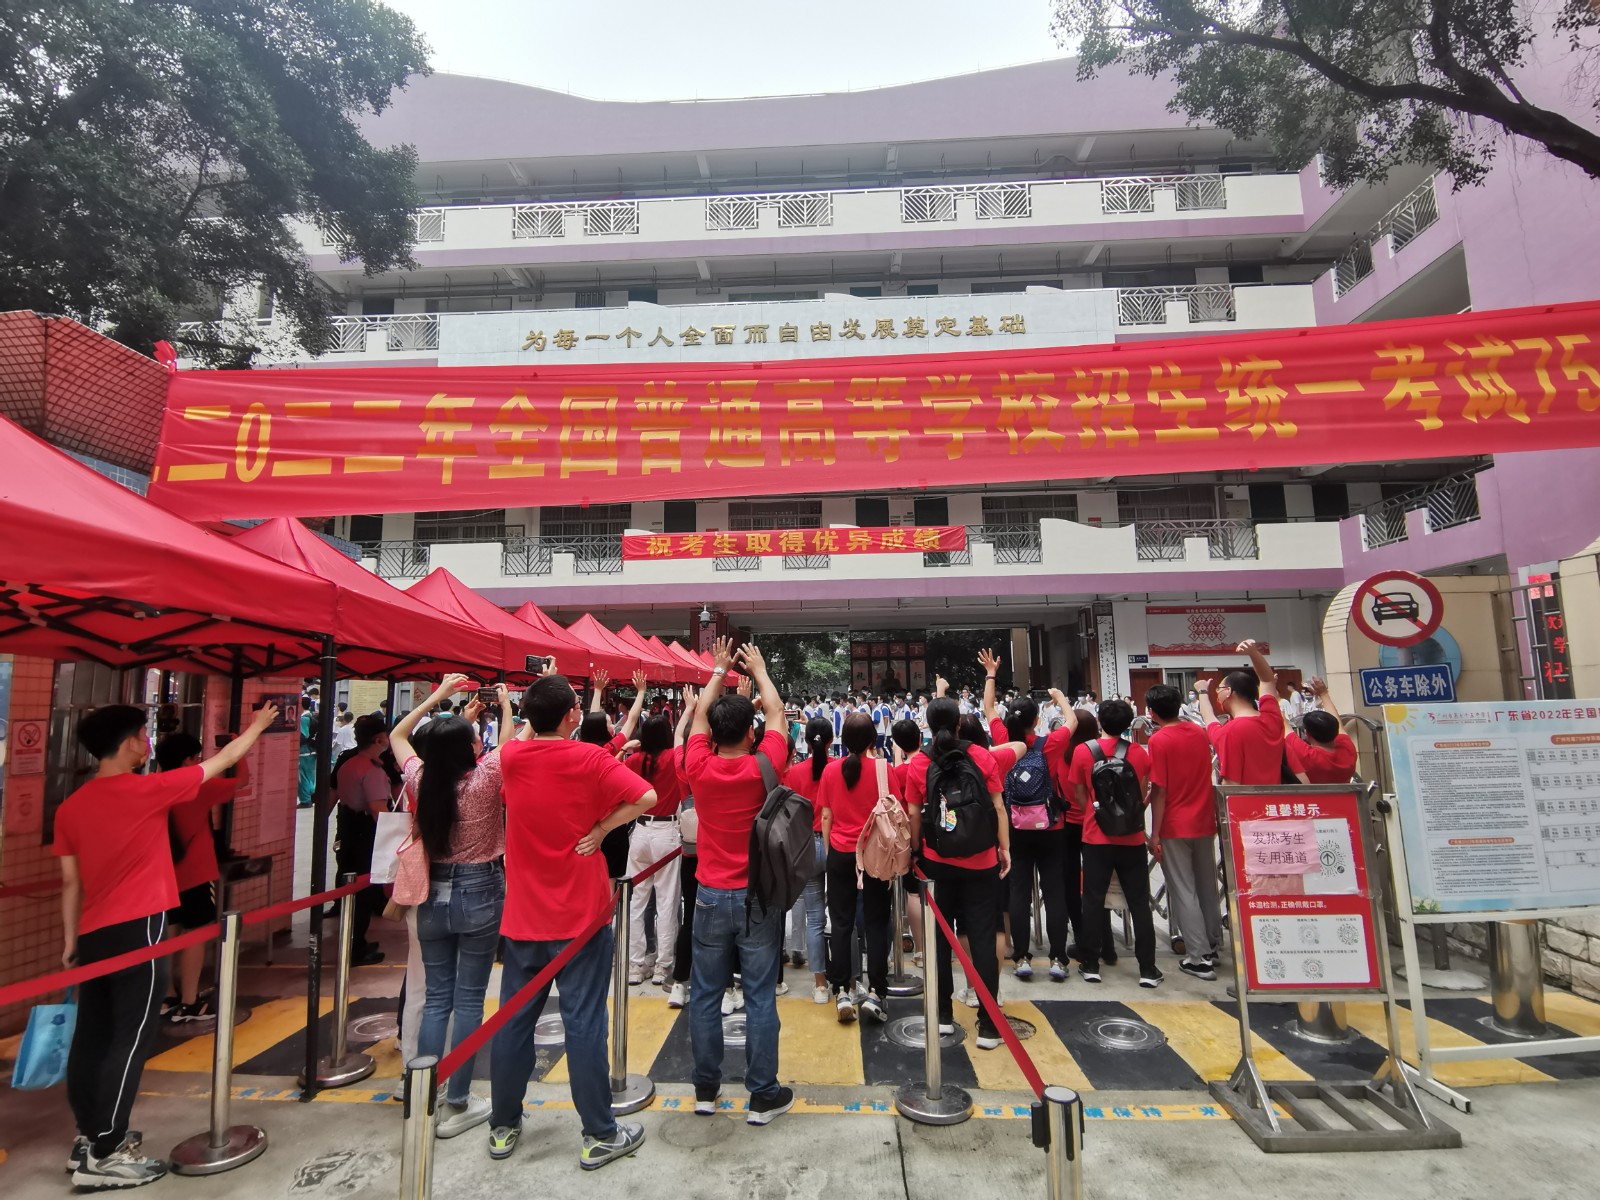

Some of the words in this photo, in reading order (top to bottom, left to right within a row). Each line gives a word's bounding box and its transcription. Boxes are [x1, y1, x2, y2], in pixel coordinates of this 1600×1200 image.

[522, 315, 1026, 351] 为每一个人全面而自由发展奠定基础
[647, 528, 941, 556] 祝考生取得优异成绩
[1368, 674, 1447, 698] 公务车除外
[1495, 708, 1600, 726] 广东省2022年全国
[1265, 804, 1320, 817] 温馨提示
[1252, 831, 1305, 846] 发热考生
[1255, 851, 1309, 866] 专用通道
